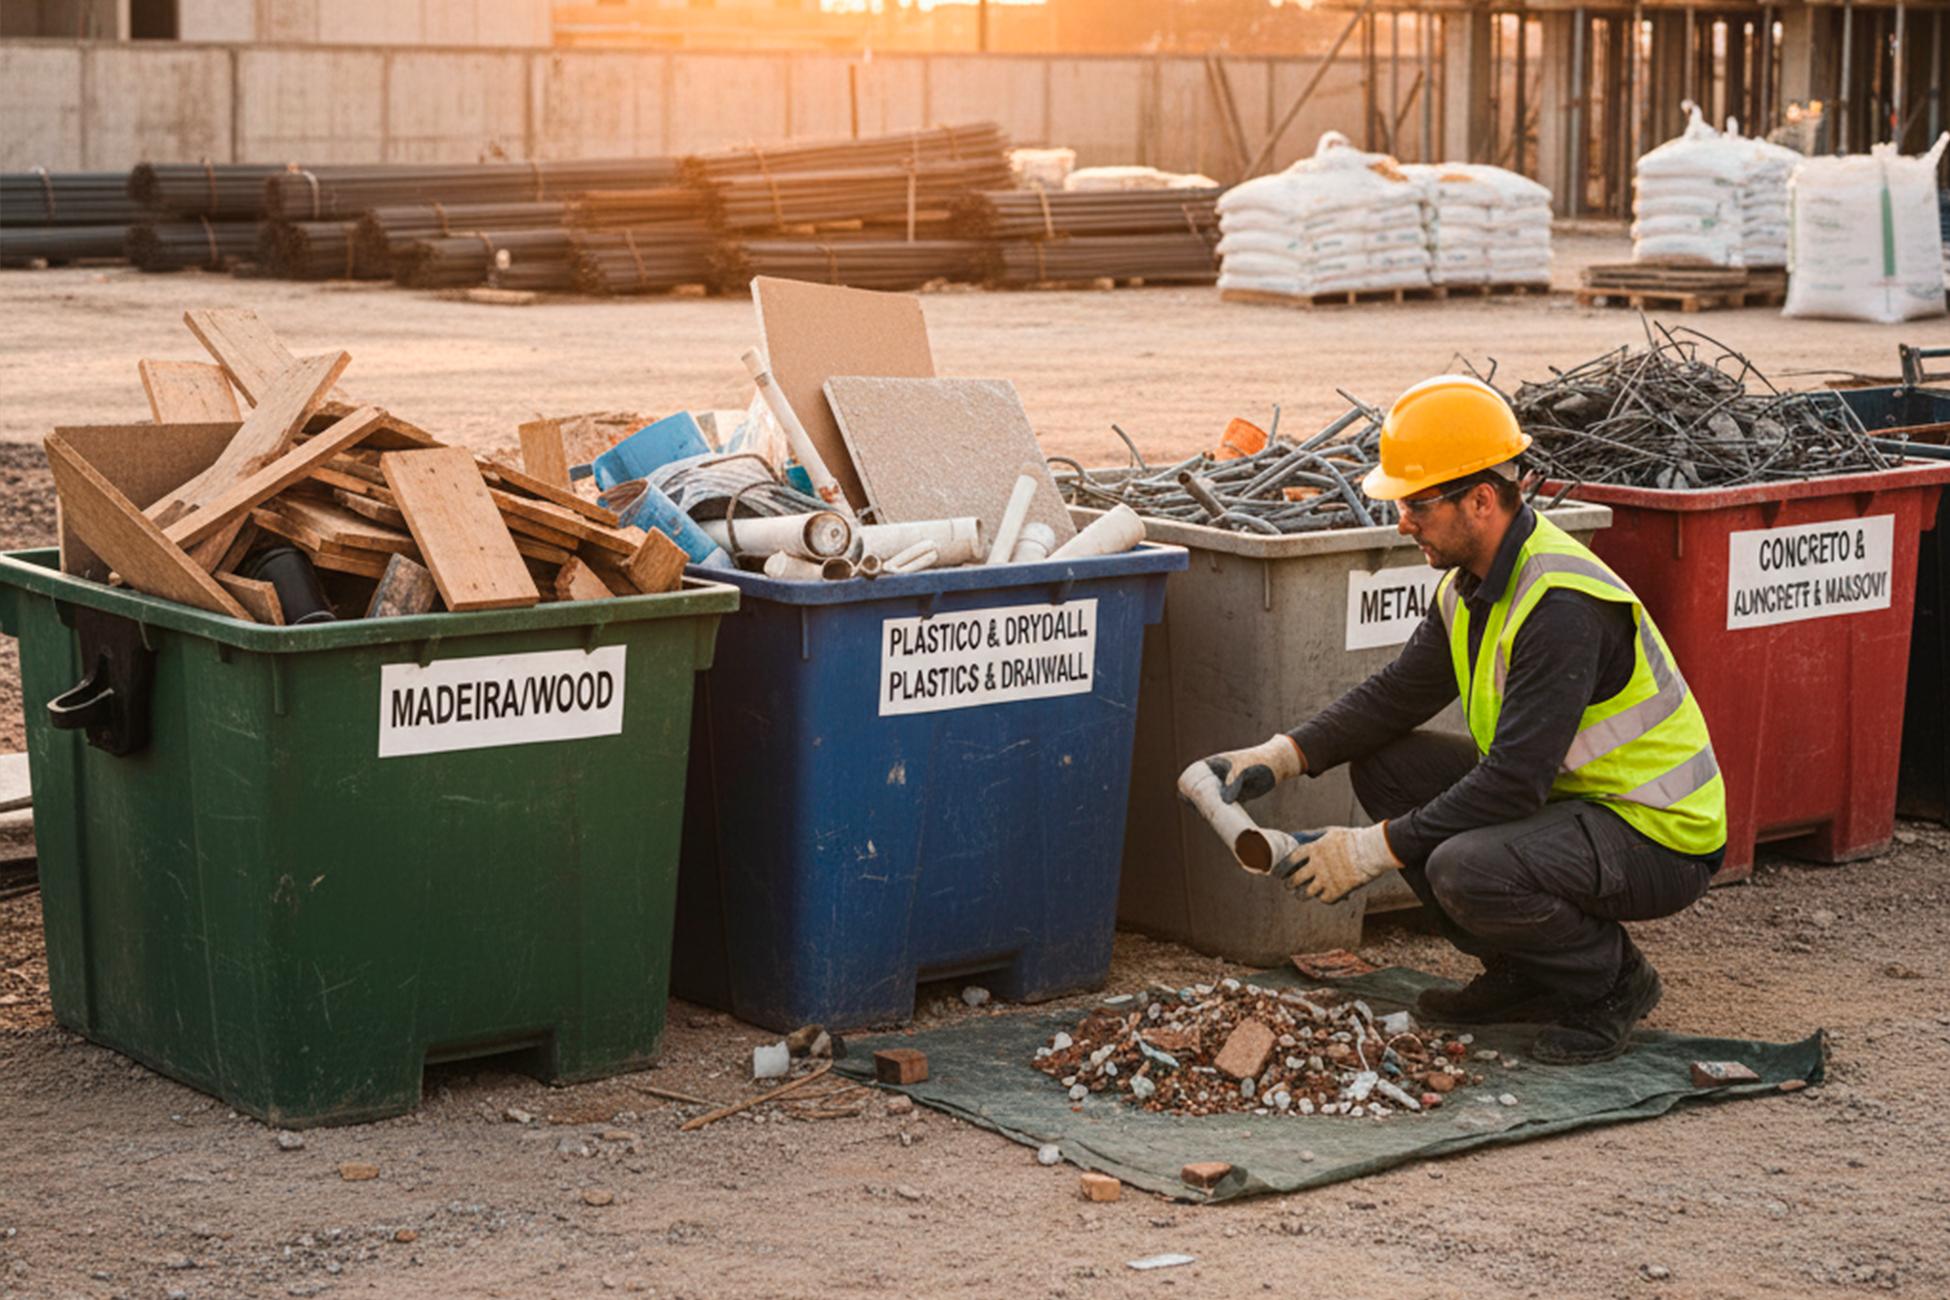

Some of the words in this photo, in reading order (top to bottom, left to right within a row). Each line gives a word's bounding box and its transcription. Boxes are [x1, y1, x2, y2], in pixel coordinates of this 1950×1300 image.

[987, 619, 1001, 648] &
[391, 671, 614, 728] MADEIRA/WOOD
[889, 663, 980, 702] PLASTICS
[984, 662, 997, 691] &
